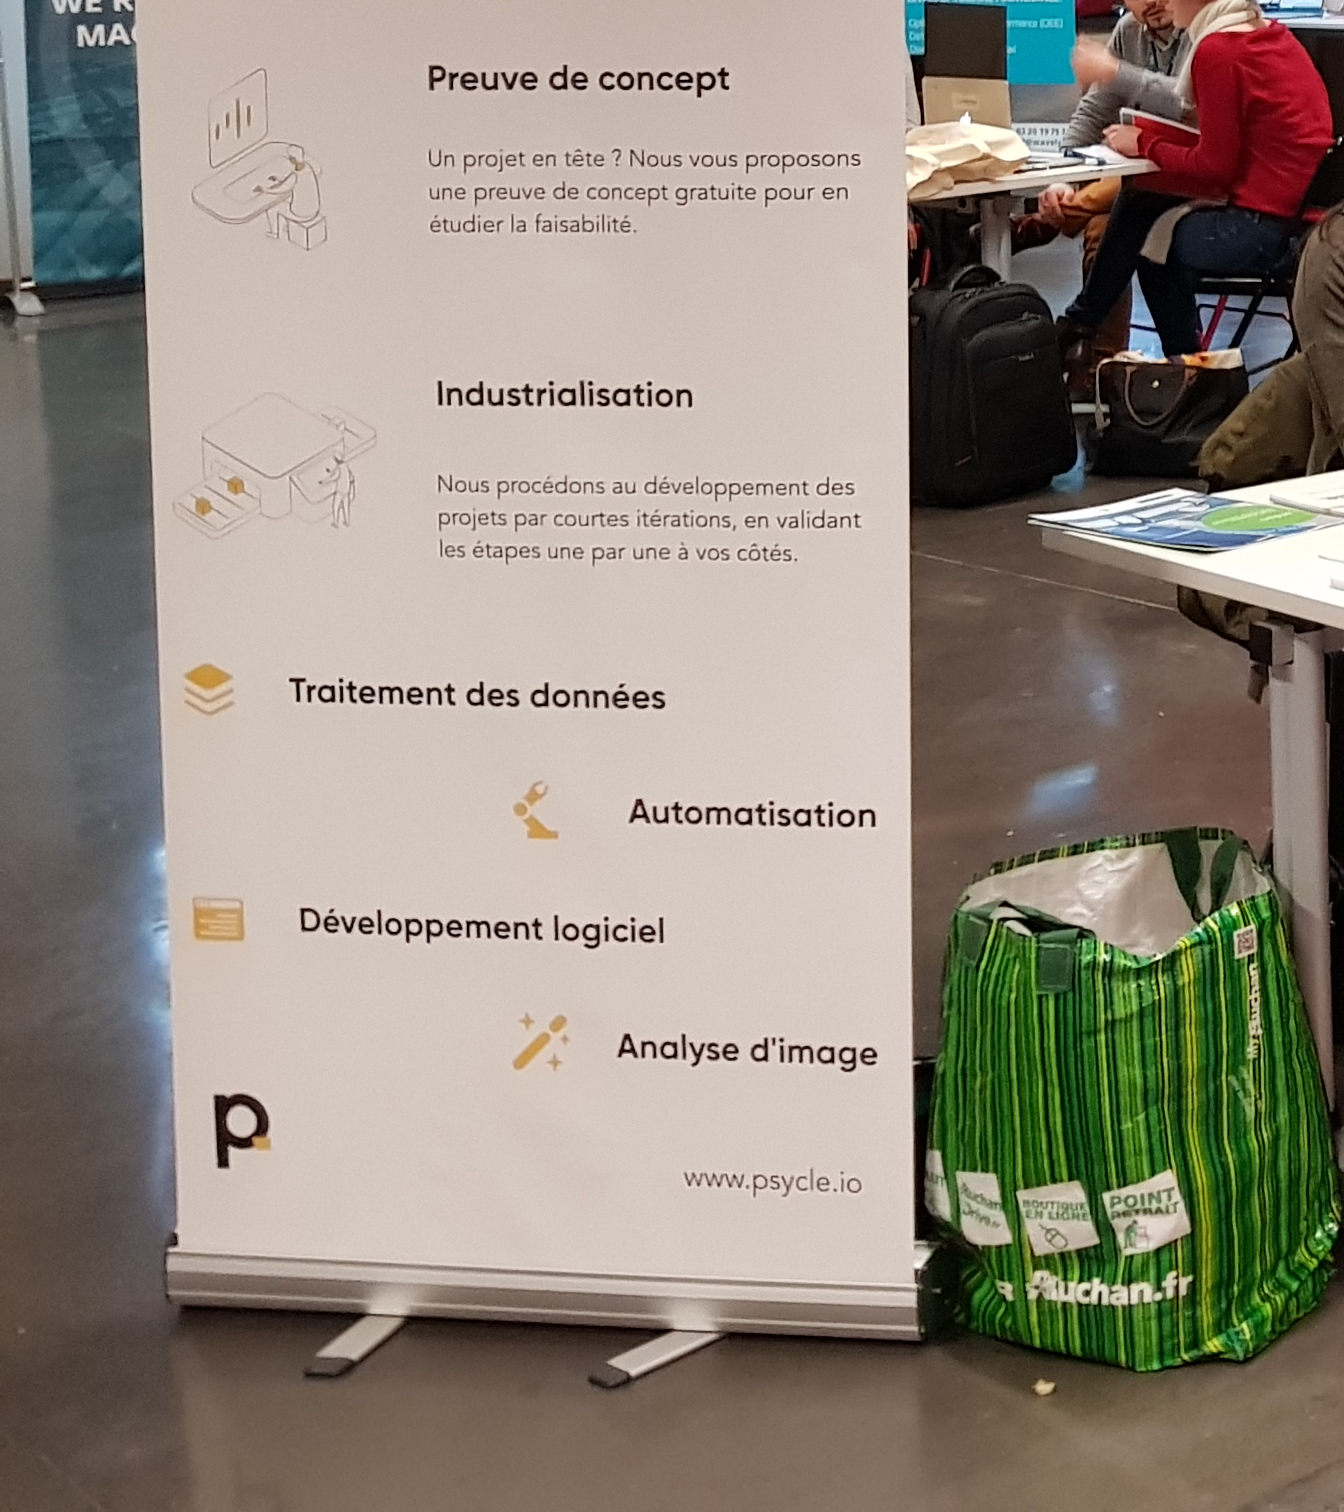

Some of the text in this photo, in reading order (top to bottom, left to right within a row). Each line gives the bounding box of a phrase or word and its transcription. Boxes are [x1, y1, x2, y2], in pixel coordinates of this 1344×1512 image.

[77, 23, 136, 47] MA
[427, 63, 731, 99] Preuve de concept
[428, 147, 862, 176] Un projet en tête ? Nous vous proposons
[428, 180, 849, 209] une preuve de concept gratuite pour en
[429, 212, 638, 234] étudier la faisabilité.
[436, 379, 694, 409] Industrialisation
[437, 473, 856, 502] Nous procédons au développement des
[438, 507, 862, 533] projets par courtes itérations, en validant
[439, 538, 799, 568] les étapes une par une à vos côtés.
[288, 676, 667, 710] Traitement des données
[627, 797, 877, 829] Automatisation
[298, 906, 665, 950] Développement logiciel
[616, 1032, 879, 1074] Analyse d'image
[683, 1167, 863, 1199] www.psycle.io
[1022, 1199, 1086, 1211] BOUTIQUE
[1109, 1187, 1175, 1209] POINT
[1111, 1202, 1180, 1220] RETRAIT
[1026, 1210, 1090, 1221] EN LIGNE
[1026, 1270, 1194, 1305] Auchan.fr
